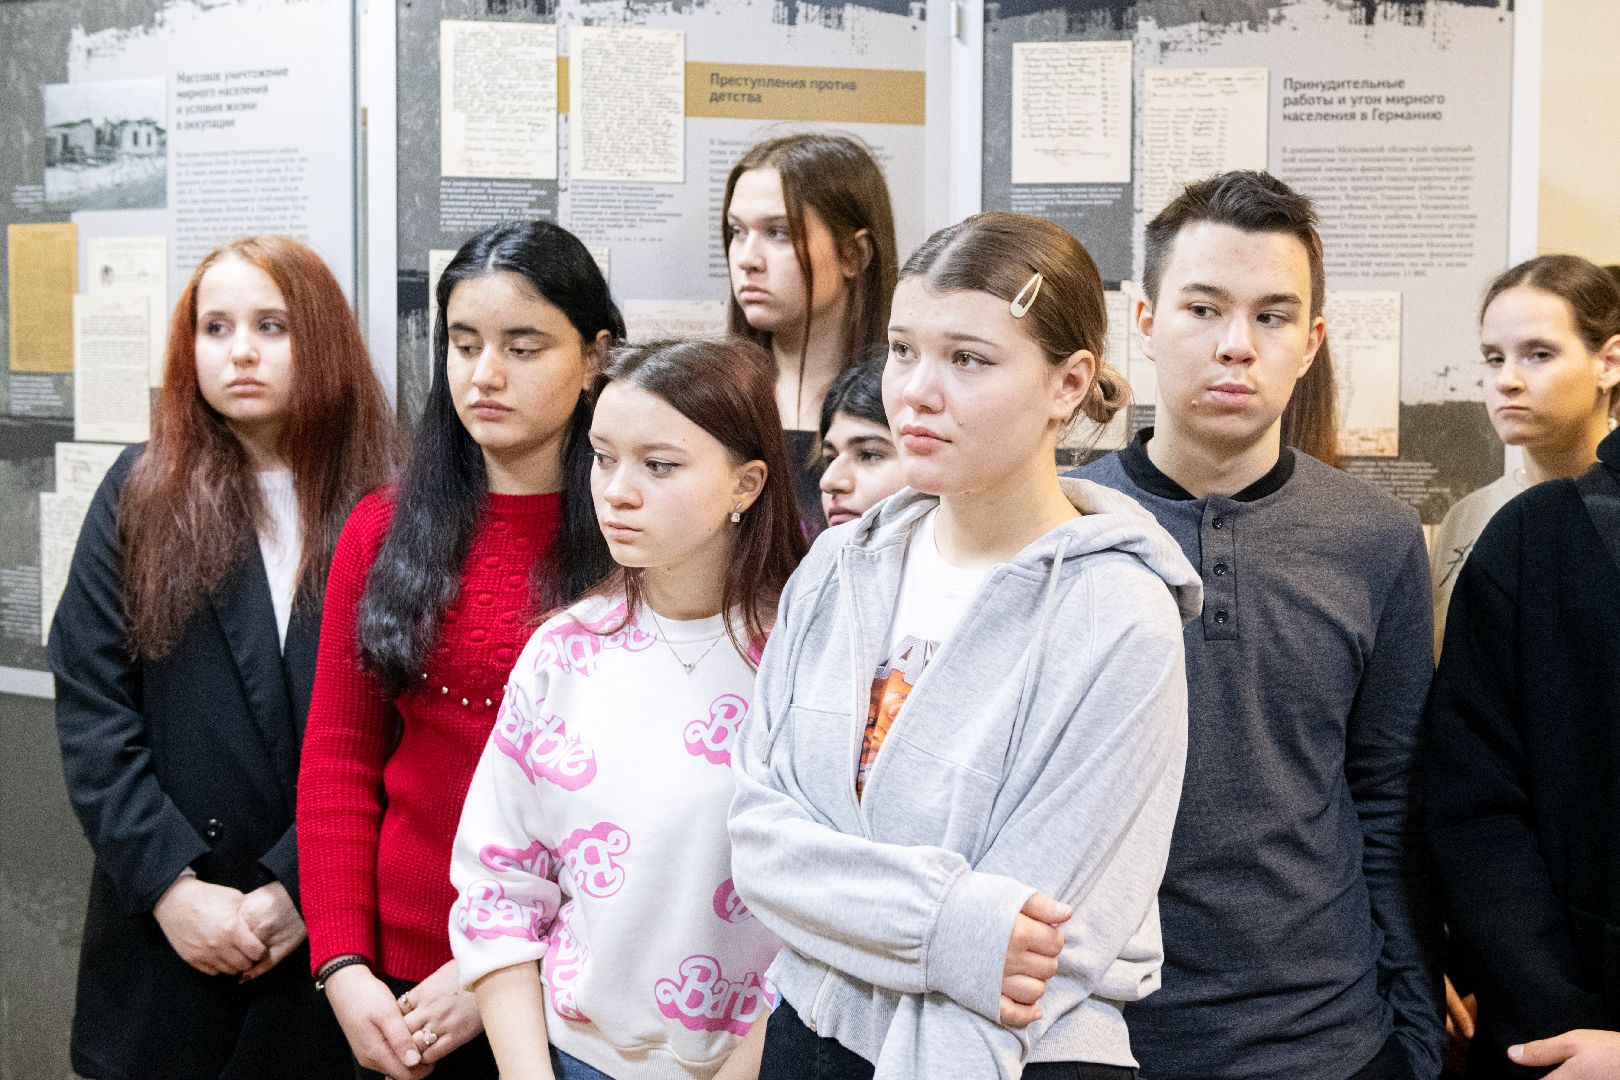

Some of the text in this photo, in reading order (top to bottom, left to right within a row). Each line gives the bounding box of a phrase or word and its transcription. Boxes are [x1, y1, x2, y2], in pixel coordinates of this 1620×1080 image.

[176, 68, 289, 83] Массовое уничтожение
[709, 72, 857, 92] Преступления против
[1283, 77, 1405, 92] Принудительные
[176, 85, 269, 100] мирного населения
[709, 90, 762, 103] детства
[1283, 93, 1445, 108] работы и угон мирного
[176, 101, 257, 116] и условия жизни
[1282, 107, 1443, 123] населения в Германию
